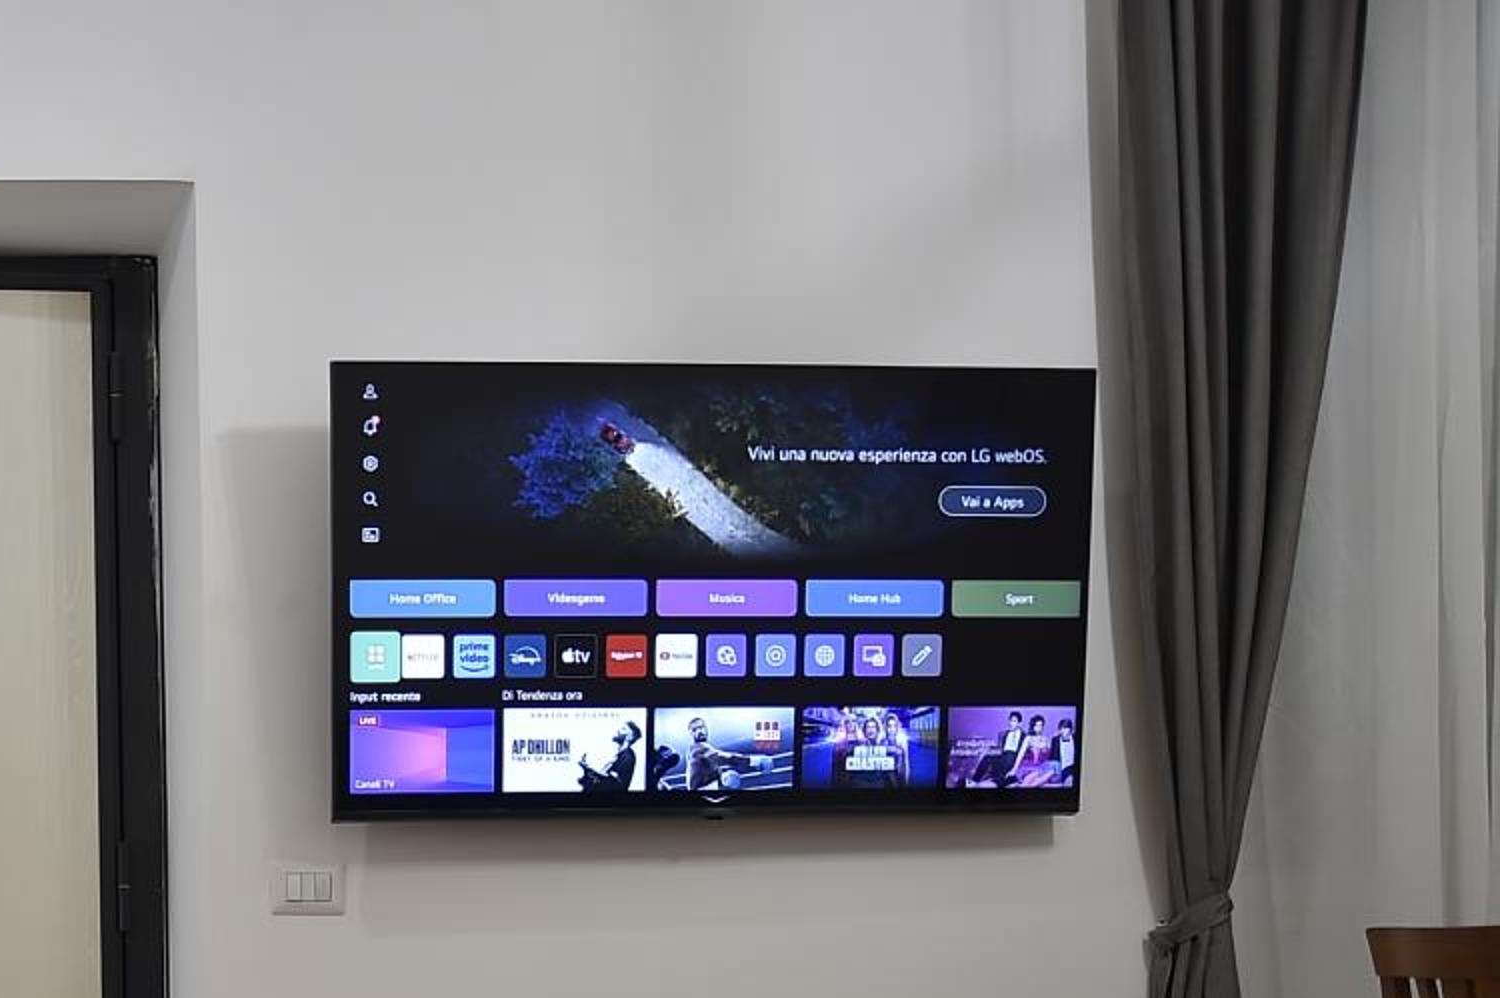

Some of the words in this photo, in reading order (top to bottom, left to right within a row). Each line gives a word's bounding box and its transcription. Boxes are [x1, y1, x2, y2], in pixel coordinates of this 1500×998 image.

[747, 446, 775, 461] Vivi
[779, 449, 806, 461] una
[810, 449, 855, 461] nuova
[858, 448, 937, 464] esperienza
[941, 451, 967, 463] con
[971, 449, 990, 463] LG
[961, 495, 981, 508] Vai
[983, 498, 990, 508] a
[993, 496, 1025, 511] Apps
[390, 594, 421, 605] Home
[423, 594, 457, 605] Office
[848, 593, 878, 604] Home
[1005, 593, 1033, 607] Sport
[459, 643, 489, 653] prime
[459, 653, 489, 663] video
[574, 648, 591, 663] tv
[349, 691, 378, 704] Input
[381, 693, 421, 702] recente
[502, 690, 514, 701] Di
[516, 690, 563, 701] Tendenza
[565, 692, 583, 701] ora
[512, 739, 526, 755] AP
